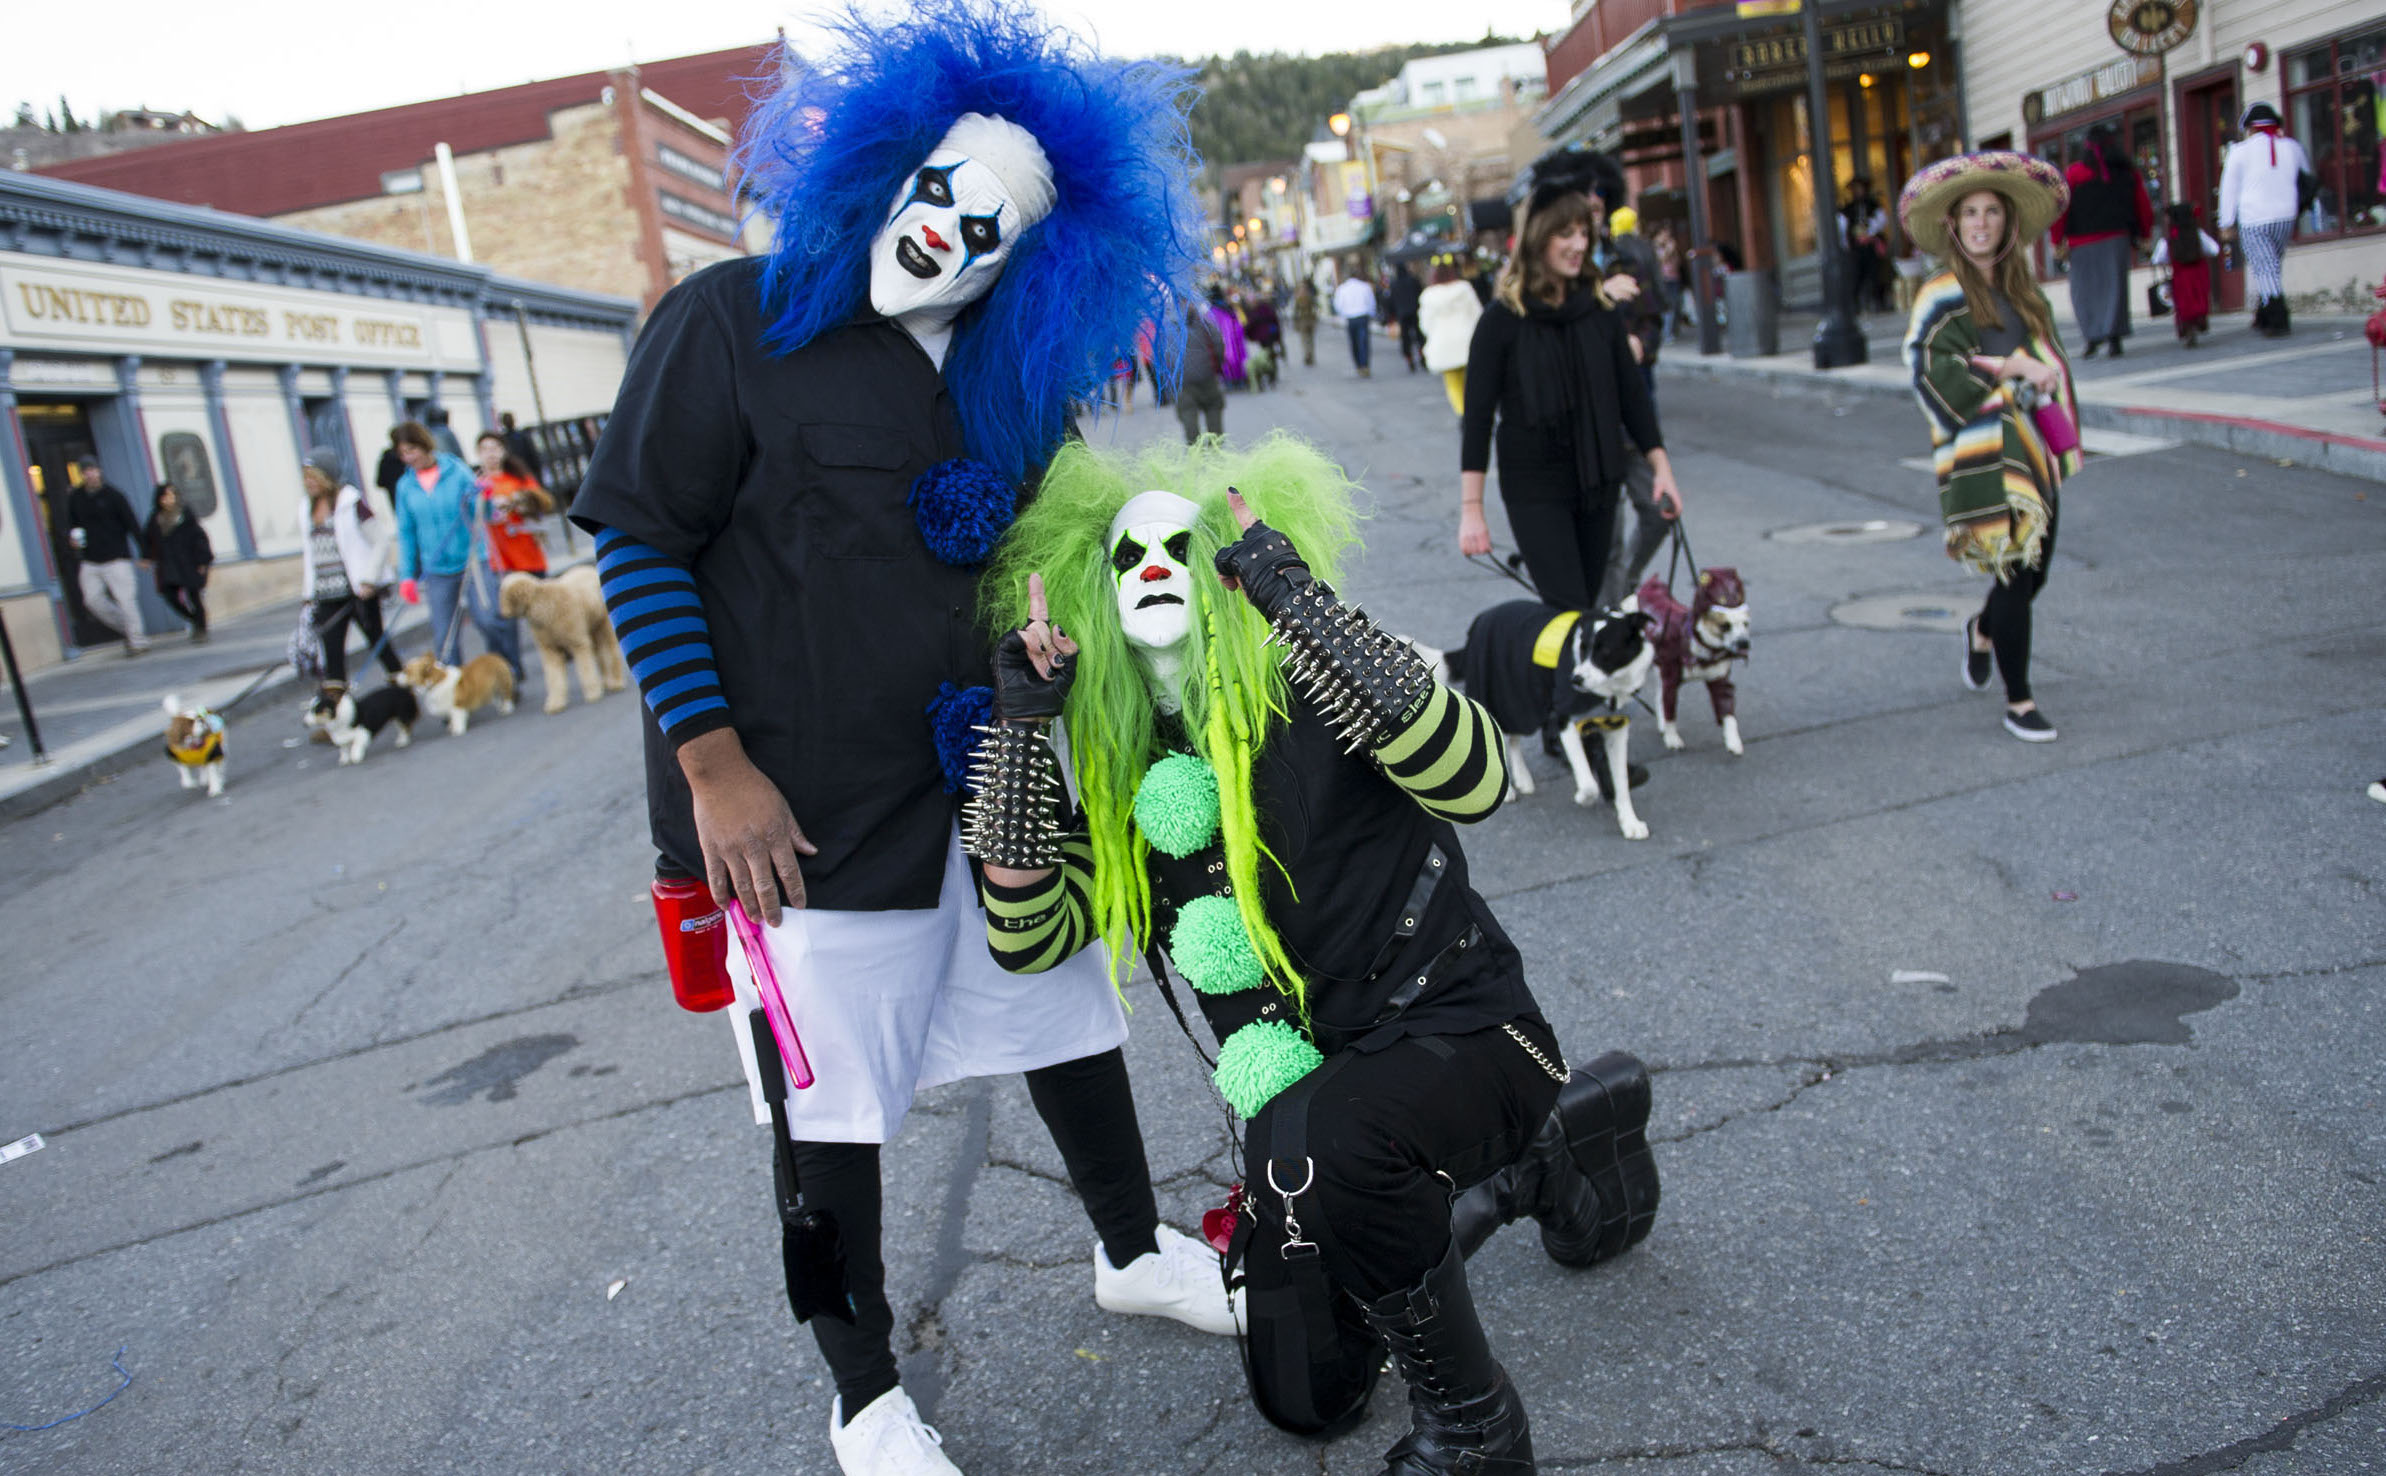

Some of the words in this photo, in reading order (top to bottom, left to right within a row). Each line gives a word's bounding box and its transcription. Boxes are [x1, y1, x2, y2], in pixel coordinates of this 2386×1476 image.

[18, 283, 151, 326] UNITED
[170, 297, 270, 336] STATES
[283, 310, 340, 342] POST
[353, 319, 422, 348] OFFICE
